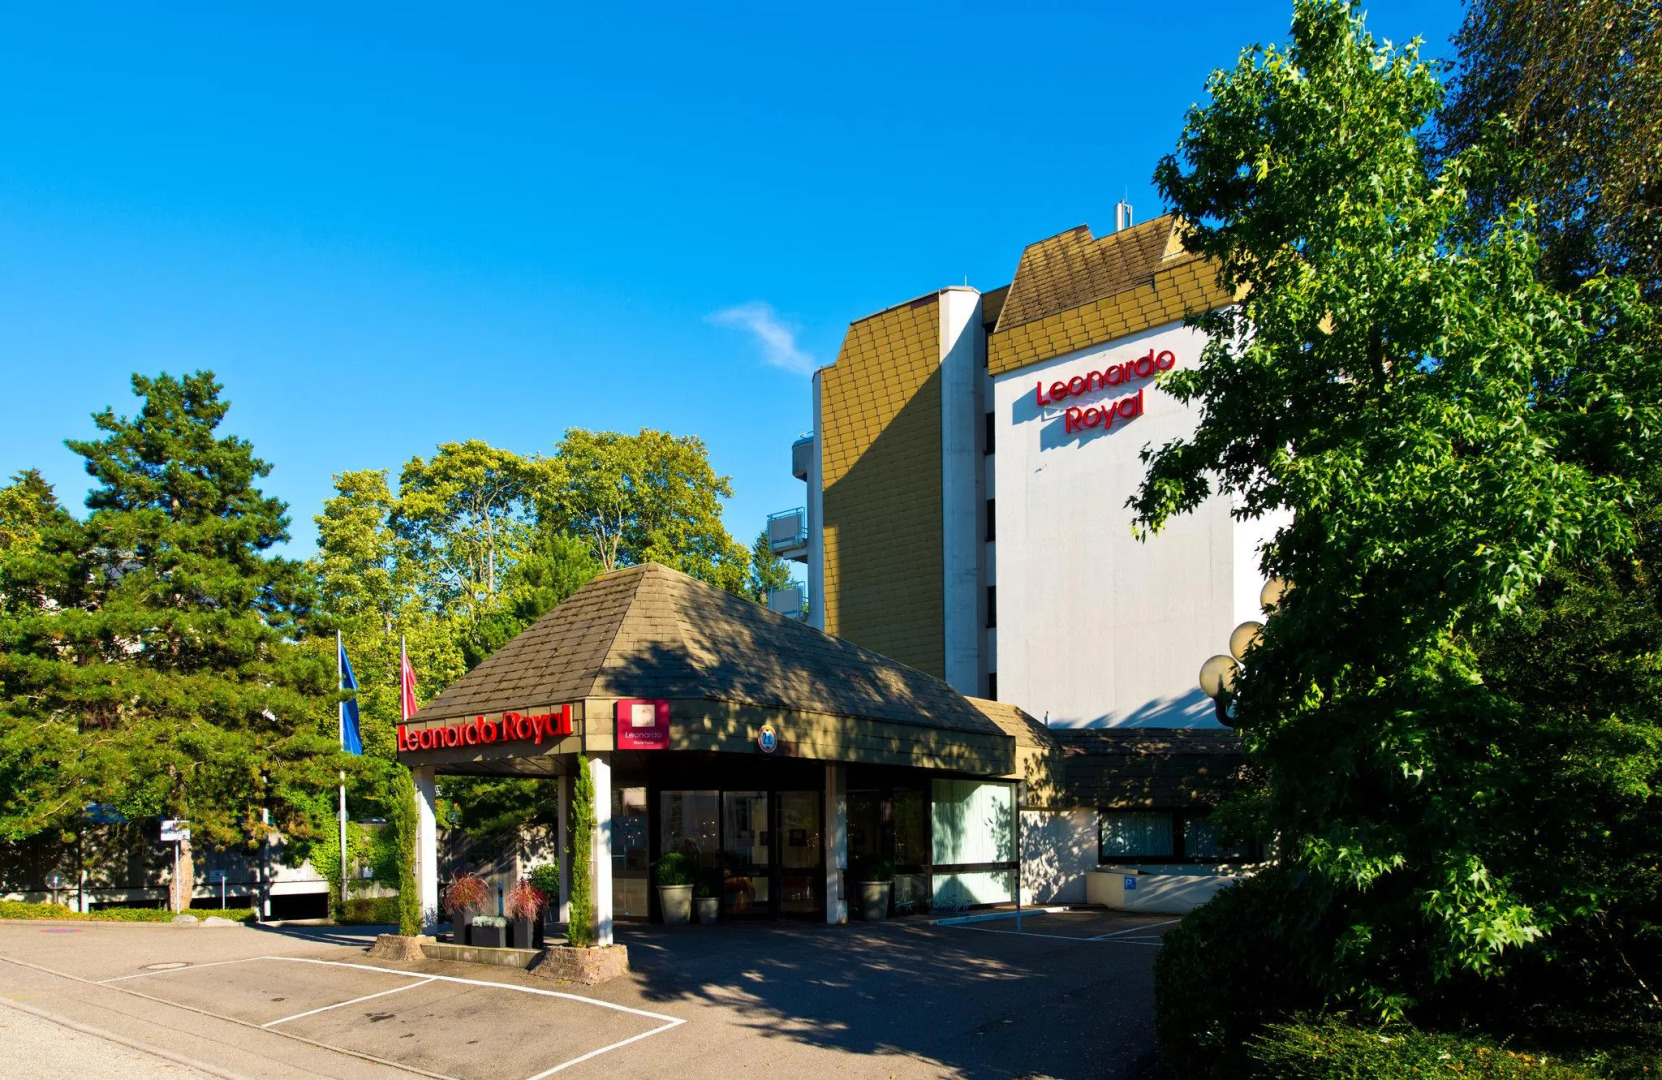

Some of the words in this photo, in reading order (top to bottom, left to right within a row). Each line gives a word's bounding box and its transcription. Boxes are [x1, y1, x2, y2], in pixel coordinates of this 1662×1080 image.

[1036, 348, 1176, 406] Leonardo
[1065, 388, 1144, 434] Royal
[397, 715, 498, 751] Leonardo
[502, 704, 573, 745] Royal
[624, 731, 663, 739] Leonardo
